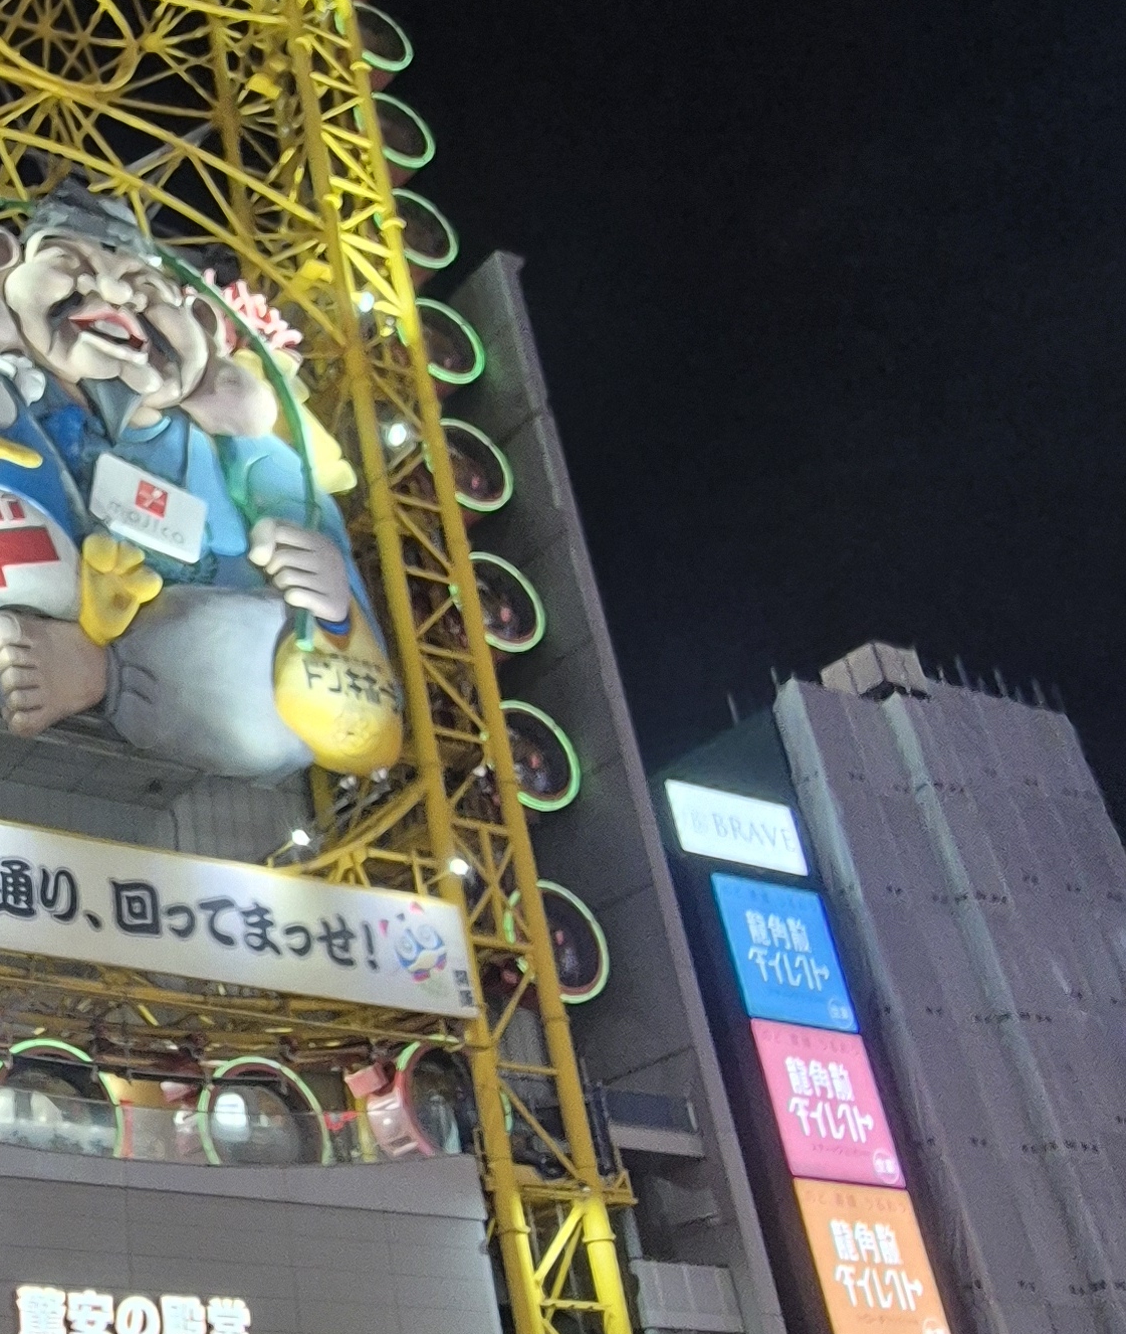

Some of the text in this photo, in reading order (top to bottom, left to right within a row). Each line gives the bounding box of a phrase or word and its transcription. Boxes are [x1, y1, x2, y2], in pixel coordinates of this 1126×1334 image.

[712, 813, 796, 853] BRAVE
[830, 1219, 903, 1266] 龍角散
[834, 1264, 924, 1311] ダイレクト
